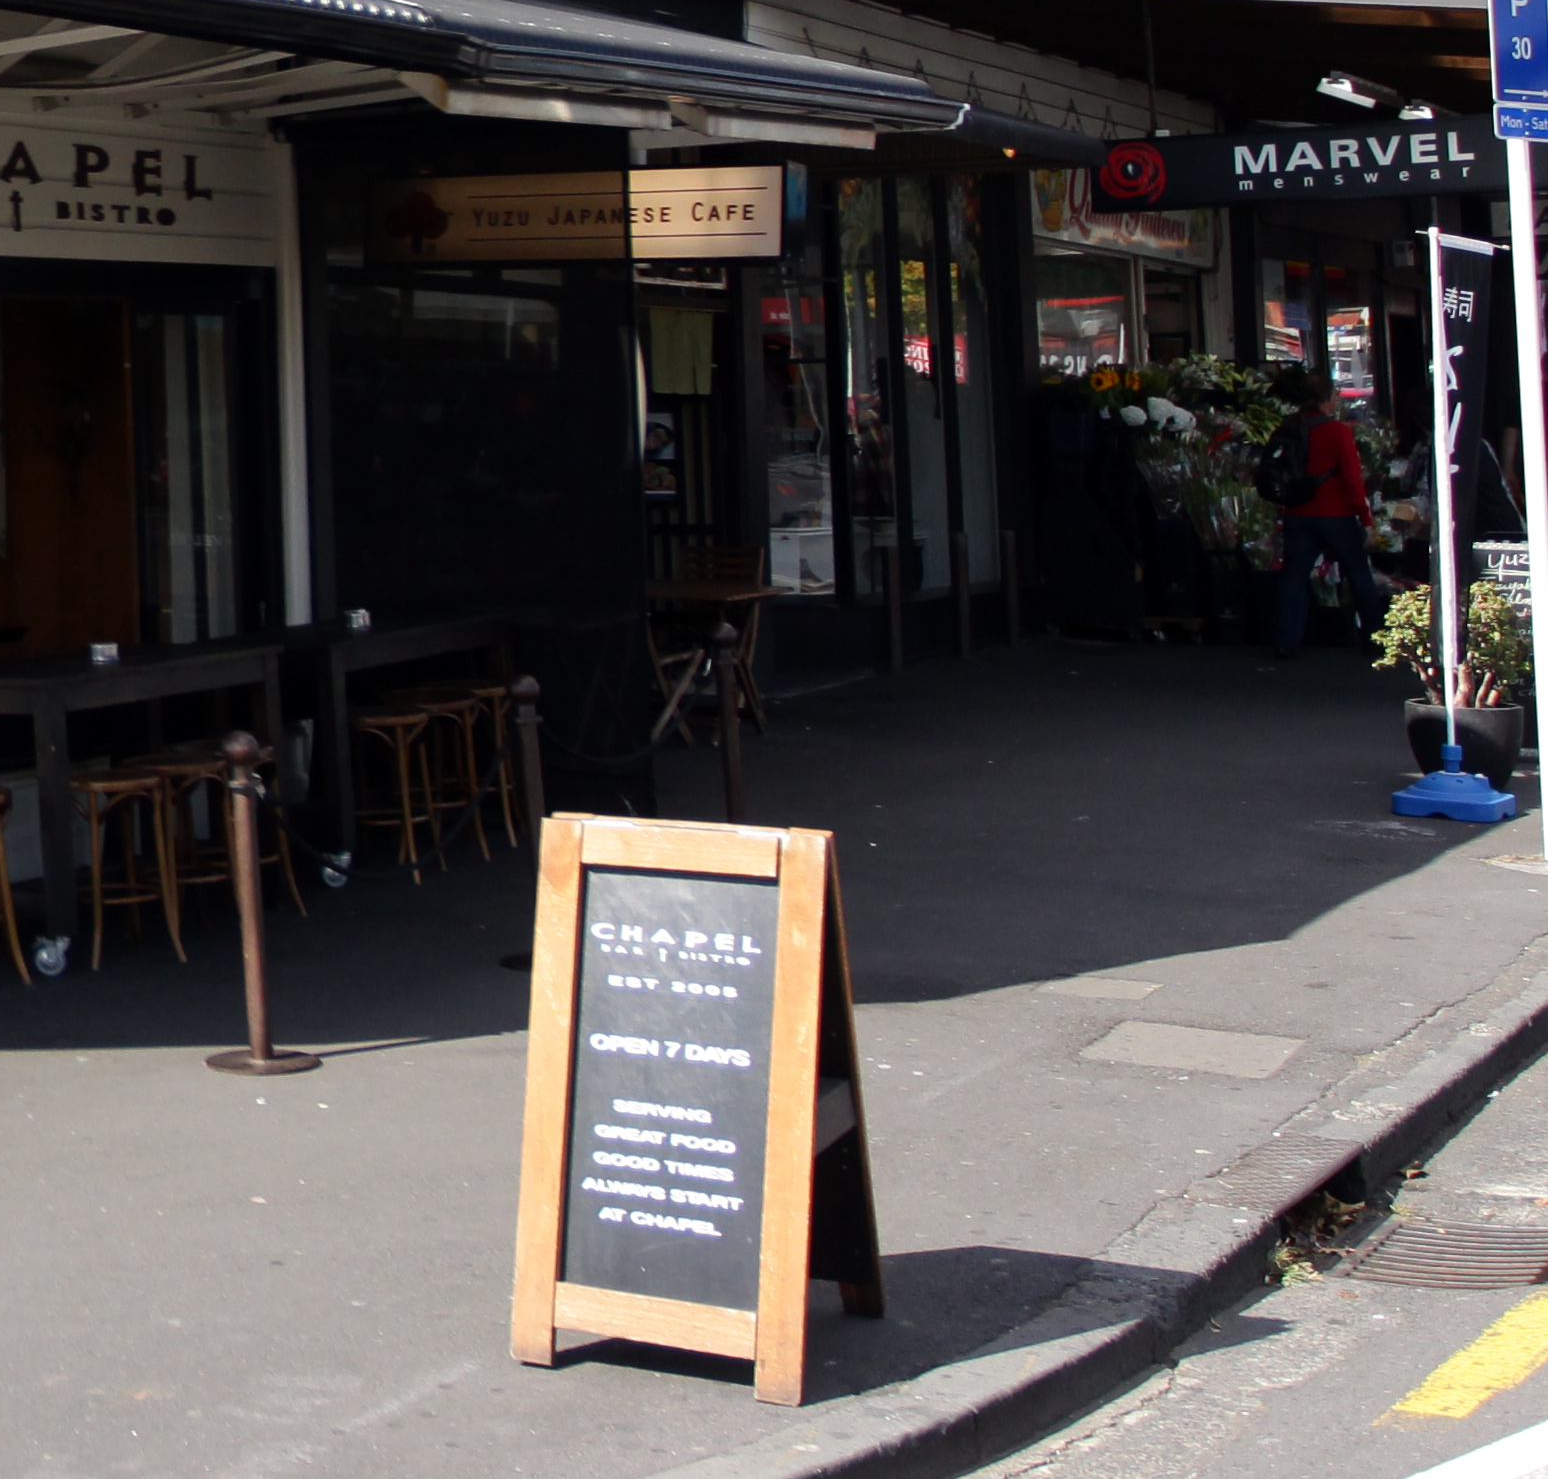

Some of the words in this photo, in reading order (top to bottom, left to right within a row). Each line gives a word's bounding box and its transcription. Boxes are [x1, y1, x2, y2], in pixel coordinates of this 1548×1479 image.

[1511, 36, 1532, 60] 30
[1500, 114, 1523, 129] Mon
[1233, 130, 1476, 176] MARVEL
[1238, 164, 1472, 192] menswear
[55, 199, 177, 228] BISTRO
[590, 922, 762, 955] CHAPEL
[599, 943, 644, 956] BAR
[677, 950, 752, 966] BISTRO
[607, 974, 660, 990] EST
[670, 981, 739, 998] 2005
[589, 1033, 660, 1058] OPEN
[664, 1040, 683, 1060] 7
[685, 1045, 751, 1068] DAYS
[611, 1099, 713, 1124] SERVING
[593, 1124, 666, 1148] GREAT
[670, 1132, 737, 1155] FOOD
[592, 1150, 661, 1174] GOOD
[664, 1158, 735, 1183] TIMES
[581, 1177, 666, 1203] ALWAYS
[668, 1187, 745, 1213] START
[598, 1207, 628, 1224] AT
[630, 1210, 723, 1238] CHAPEL
